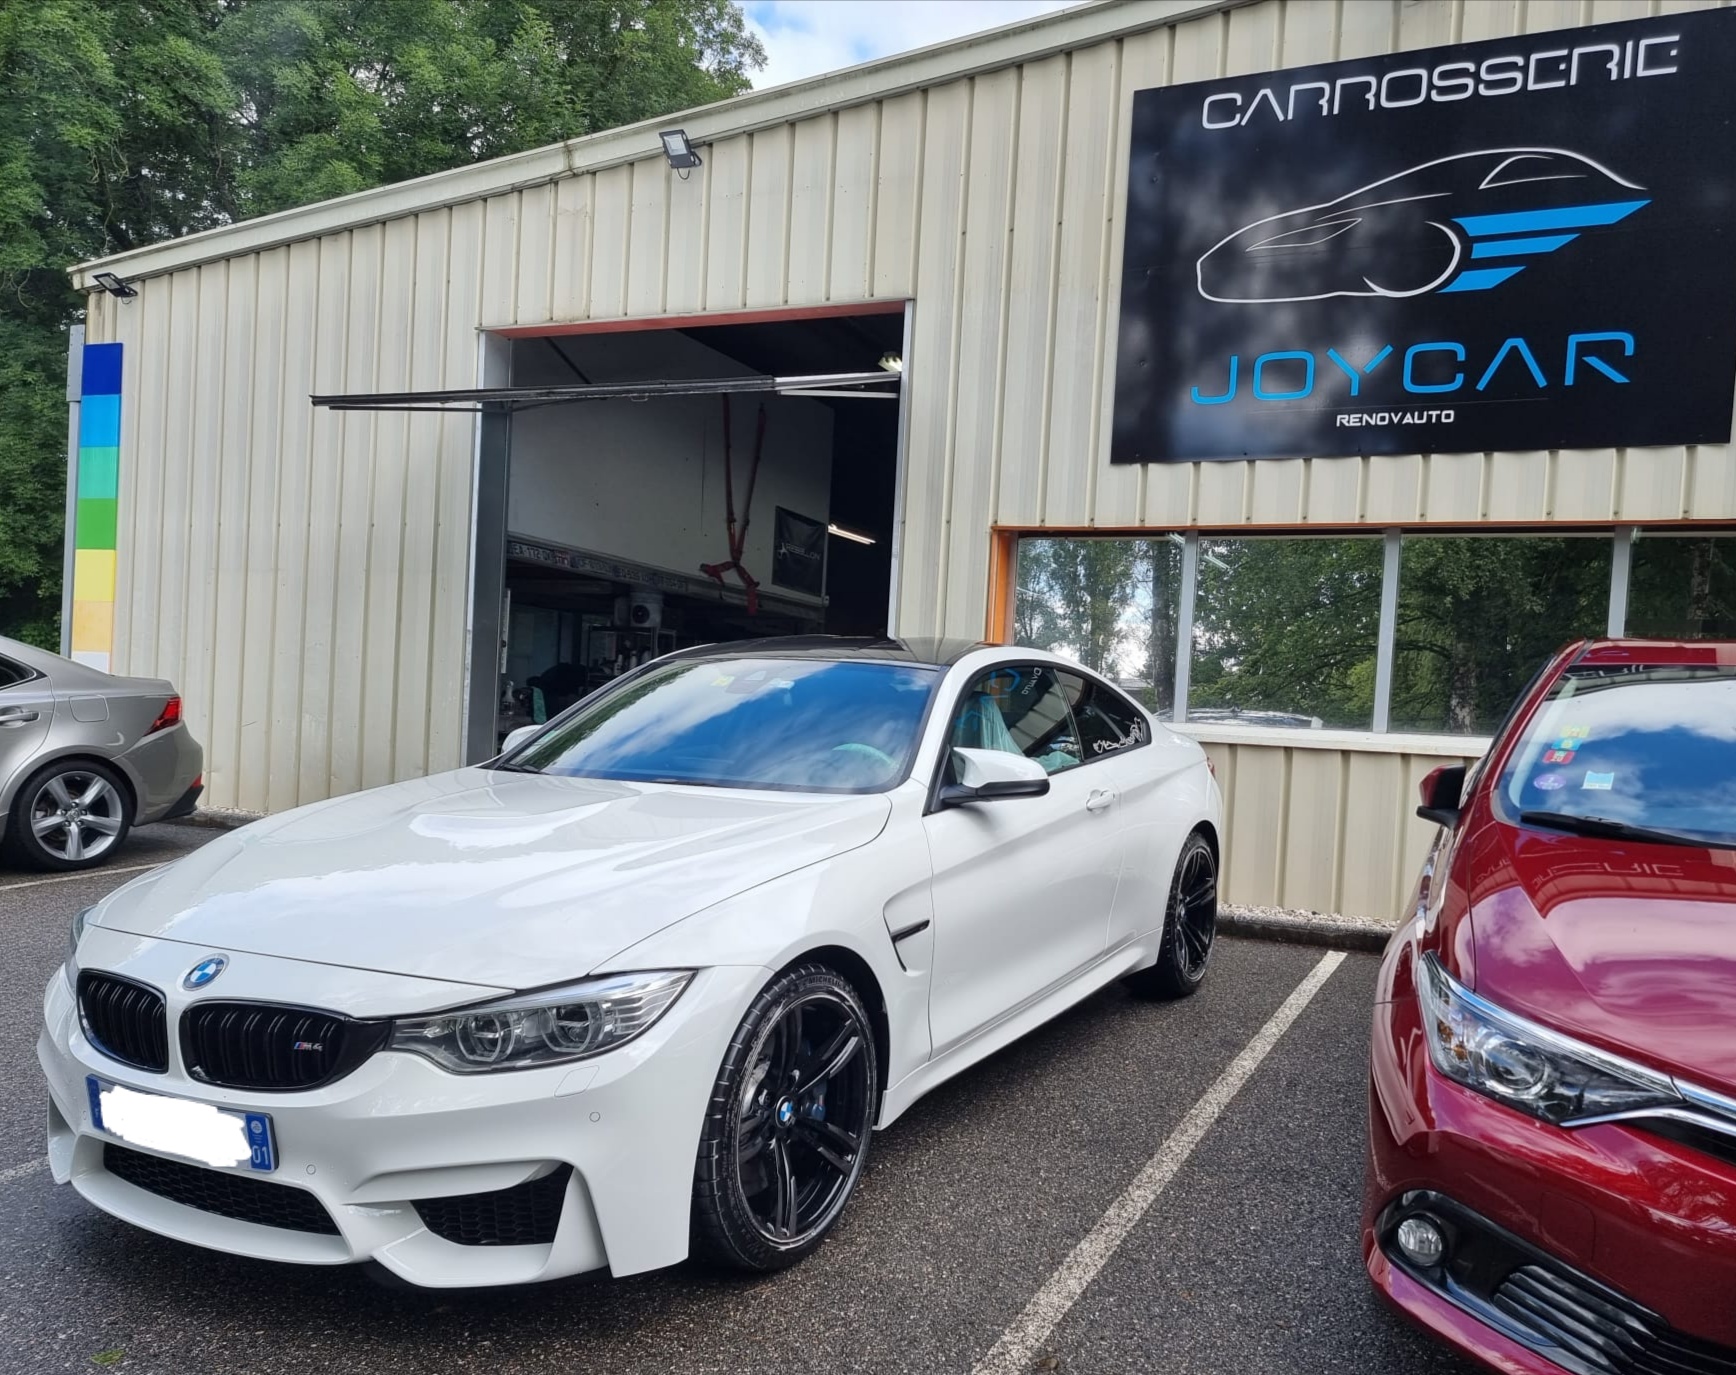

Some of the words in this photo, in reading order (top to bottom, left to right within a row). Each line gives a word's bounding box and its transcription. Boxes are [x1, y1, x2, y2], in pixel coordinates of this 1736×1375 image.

[1202, 35, 1681, 130] CARROSSERIE
[1191, 331, 1636, 405] JOYCAR
[1336, 410, 1456, 428] RENOVAUTO
[251, 1145, 270, 1165] 01
